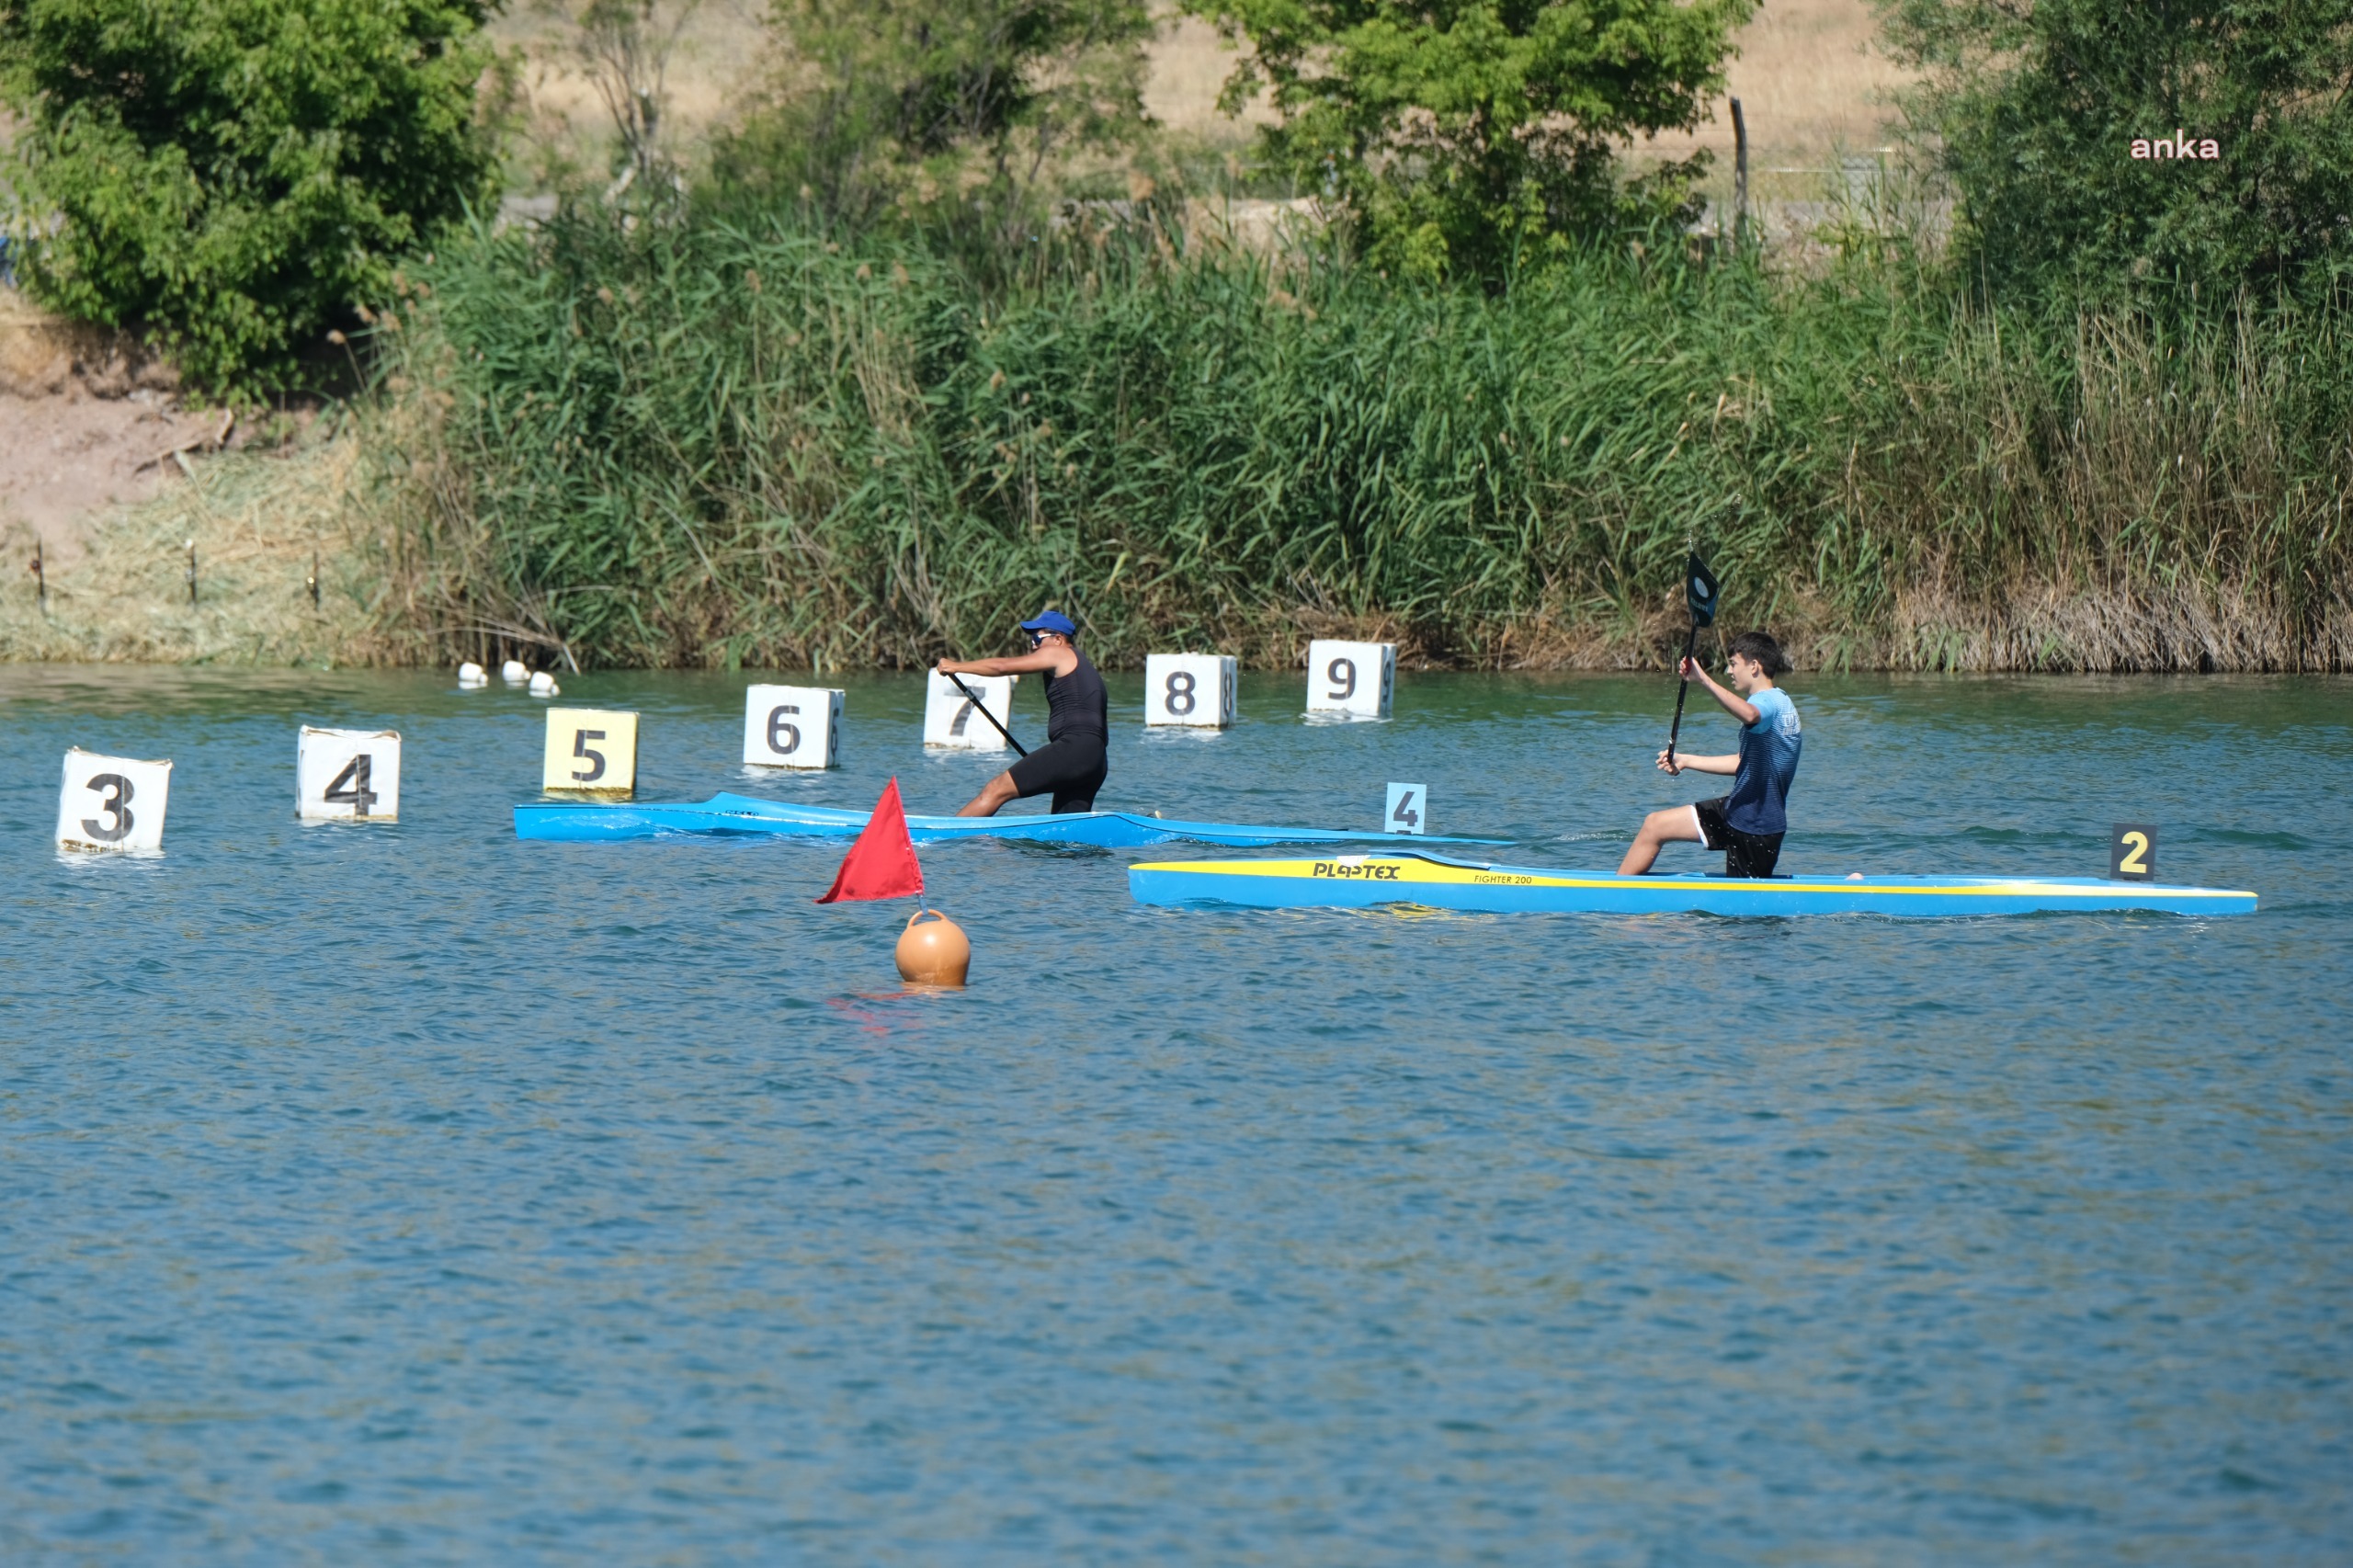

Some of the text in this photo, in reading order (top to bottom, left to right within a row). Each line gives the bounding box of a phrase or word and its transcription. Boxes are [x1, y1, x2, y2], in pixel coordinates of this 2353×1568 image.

[1165, 670, 1196, 716] 8
[1327, 657, 1357, 700] 9
[766, 704, 801, 755] 6
[942, 685, 986, 737] 7
[572, 729, 607, 782] 5
[80, 773, 135, 843] 3
[324, 754, 378, 816] 4
[1392, 790, 1418, 827] 4
[2120, 830, 2148, 874] 2
[1473, 875, 1532, 884] FIGHTER 200
